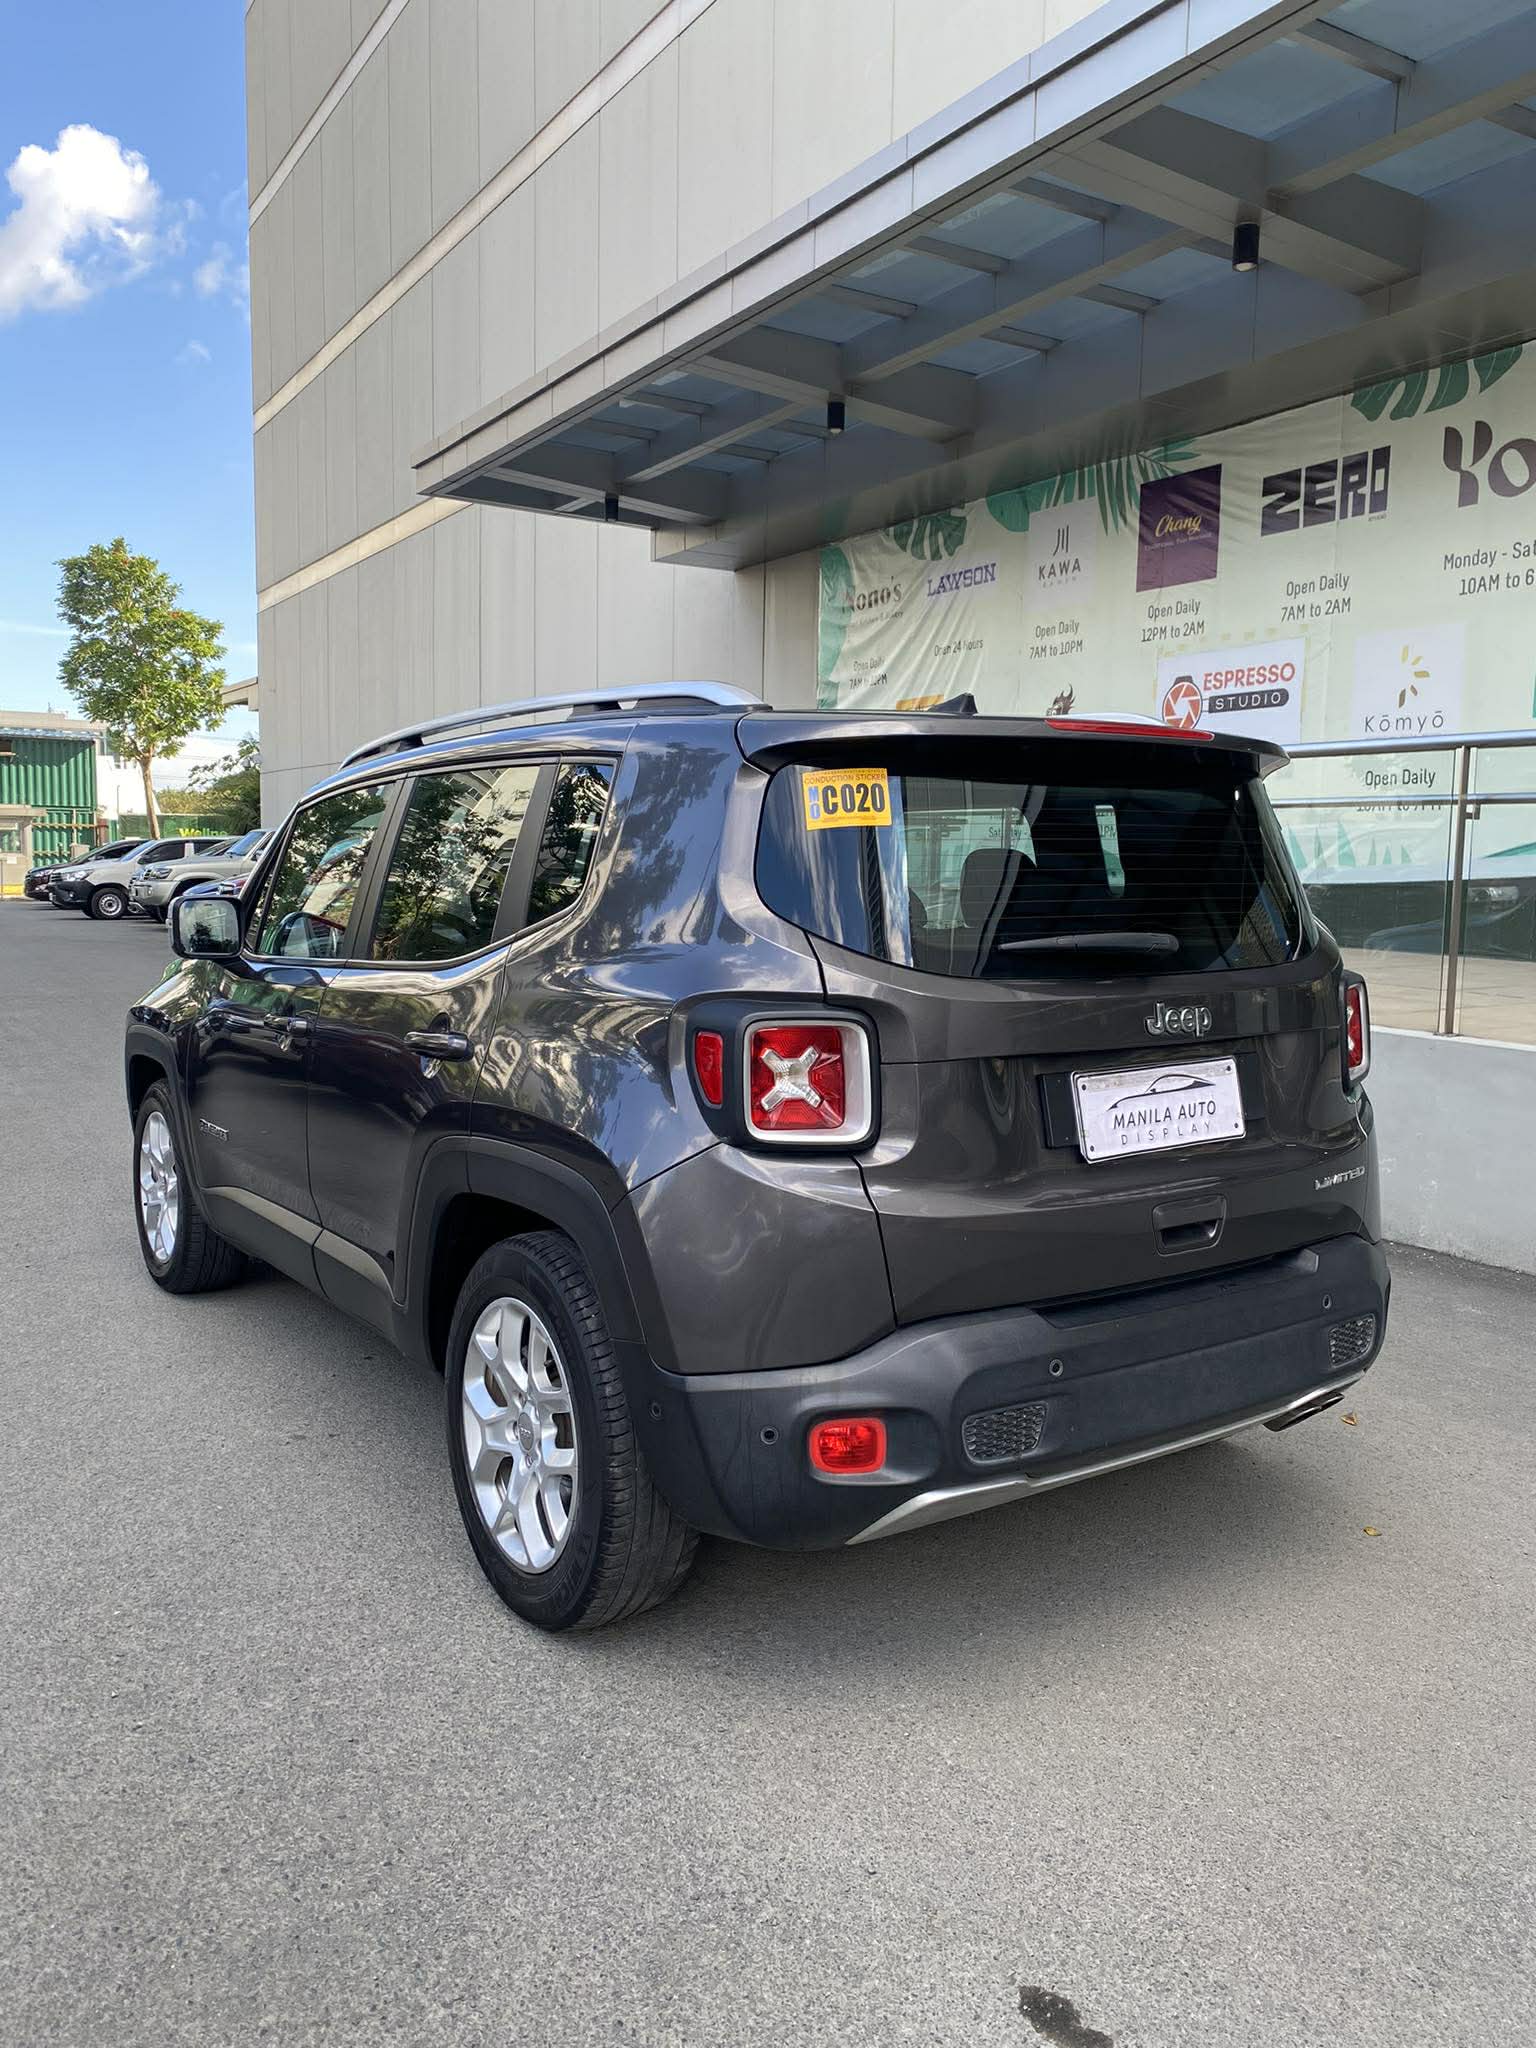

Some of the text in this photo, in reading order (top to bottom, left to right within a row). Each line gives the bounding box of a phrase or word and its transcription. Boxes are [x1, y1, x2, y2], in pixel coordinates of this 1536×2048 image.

[1261, 445, 1391, 537] ZERO
[1155, 514, 1202, 538] Chang
[1038, 558, 1081, 580] KAWA
[1443, 549, 1497, 571] Monday
[927, 562, 997, 597] LAWSON
[1286, 573, 1350, 599] Open Daily
[1459, 574, 1499, 596] 10AM
[1505, 572, 1520, 588] to
[1148, 599, 1201, 622] Open Daily
[1281, 597, 1351, 623] 7AM to 2AM
[1035, 619, 1080, 640] Open Daily
[1141, 620, 1205, 642] 12PM to 2AM
[1030, 639, 1083, 660] 7AM to 10PM
[1203, 662, 1295, 691] ESPRESSO
[1215, 692, 1281, 711] STUDIO
[804, 772, 887, 785] CONDUCTION STICKER
[1365, 768, 1436, 789] Open Daily
[822, 783, 885, 815] C020
[1145, 1002, 1213, 1037] Jeep
[1113, 1100, 1217, 1129] MANILA AUTO
[1121, 1121, 1213, 1146] DISPLAY
